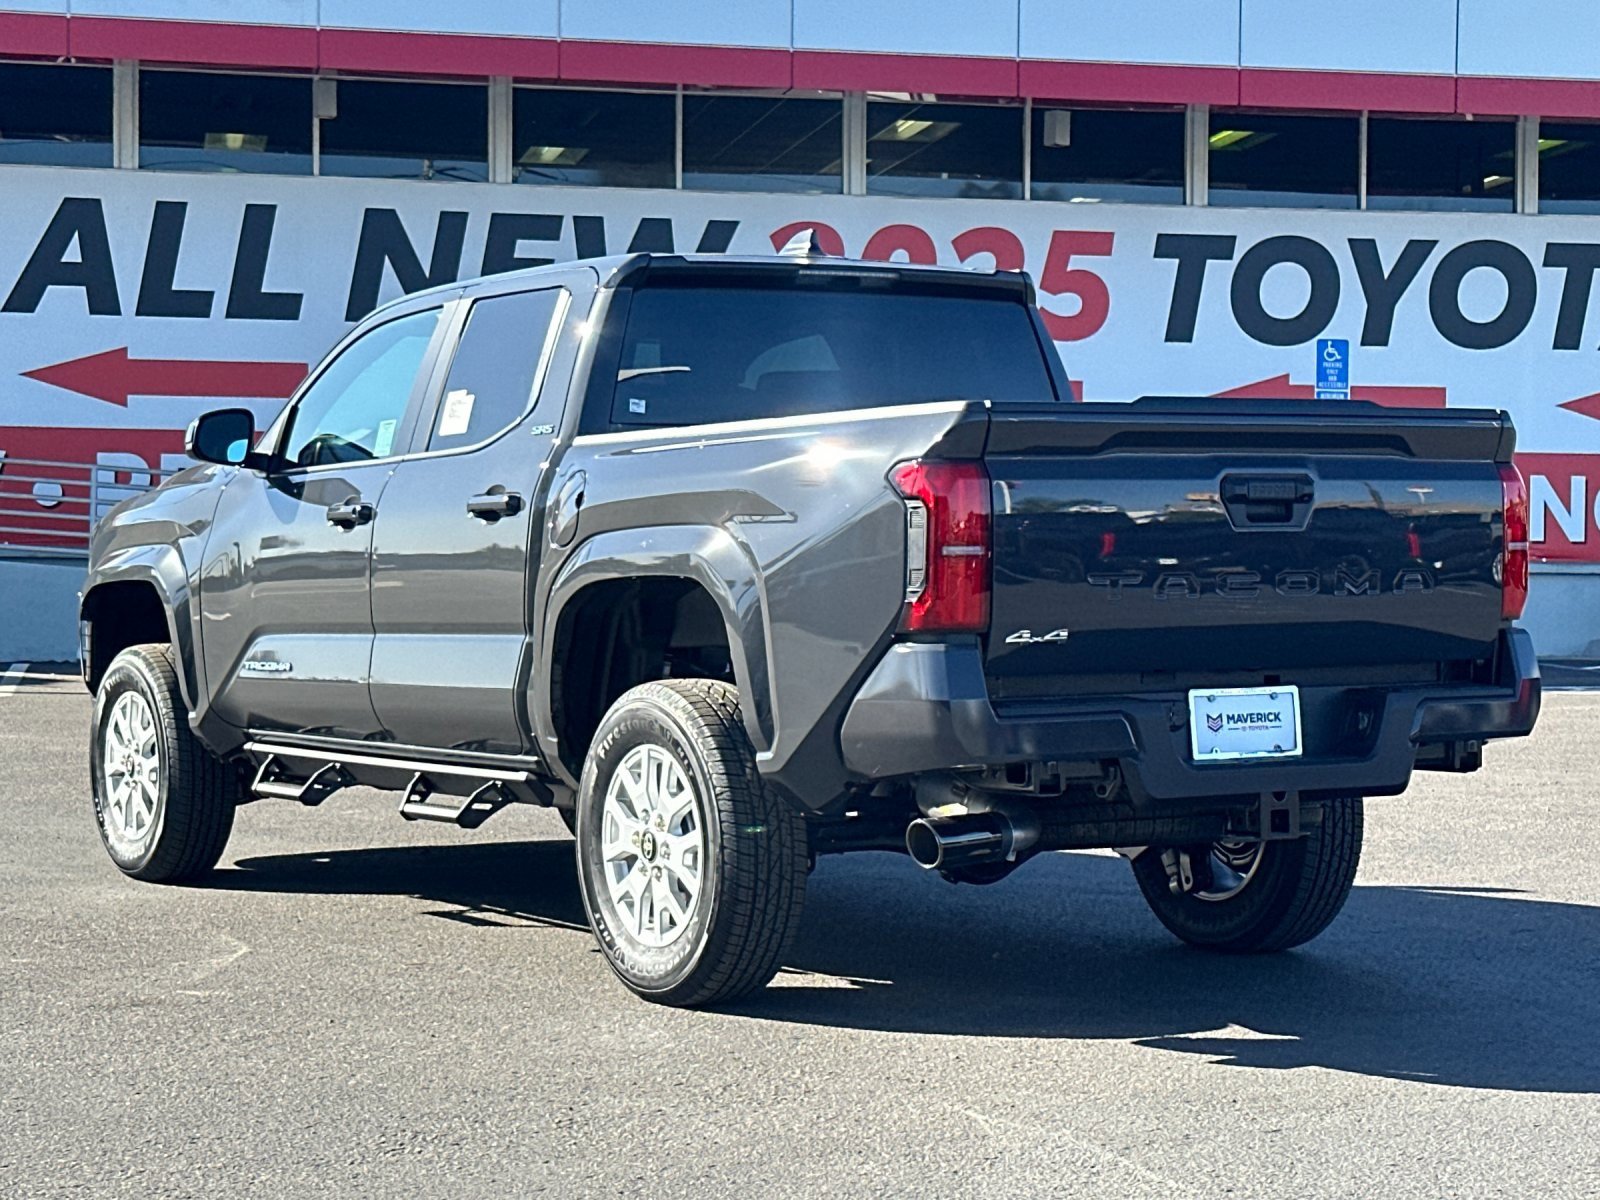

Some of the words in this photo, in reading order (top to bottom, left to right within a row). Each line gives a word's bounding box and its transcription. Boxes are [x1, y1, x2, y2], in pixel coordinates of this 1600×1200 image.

[2, 197, 304, 320] ALL
[1153, 230, 1600, 351] TOYOT
[1086, 567, 1435, 600] TACOMA
[1226, 711, 1282, 724] MAVERICK
